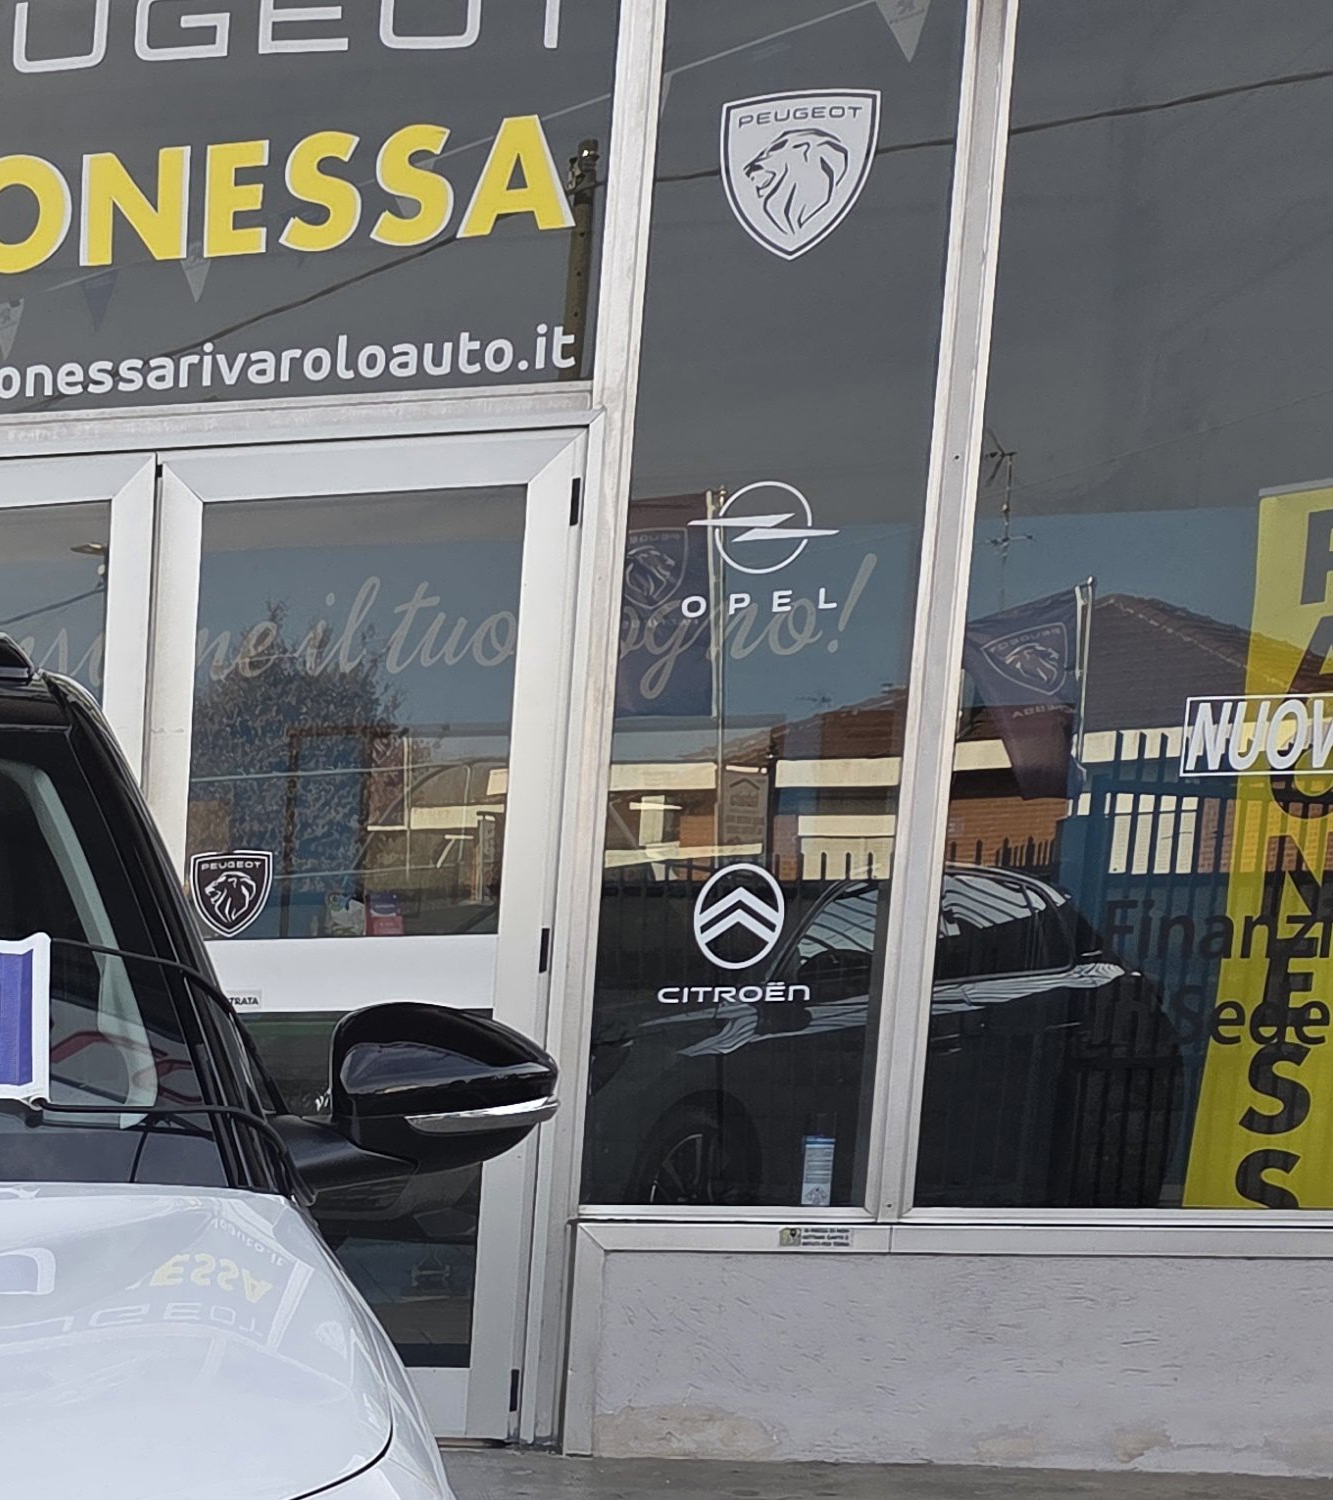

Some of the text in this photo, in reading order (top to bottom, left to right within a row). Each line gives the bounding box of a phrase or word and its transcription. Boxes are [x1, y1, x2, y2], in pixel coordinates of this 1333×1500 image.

[738, 105, 864, 129] PEUGEOT
[680, 586, 839, 619] OPEL
[200, 861, 262, 871] PEUGEOT
[657, 981, 811, 1004] CITROËN
